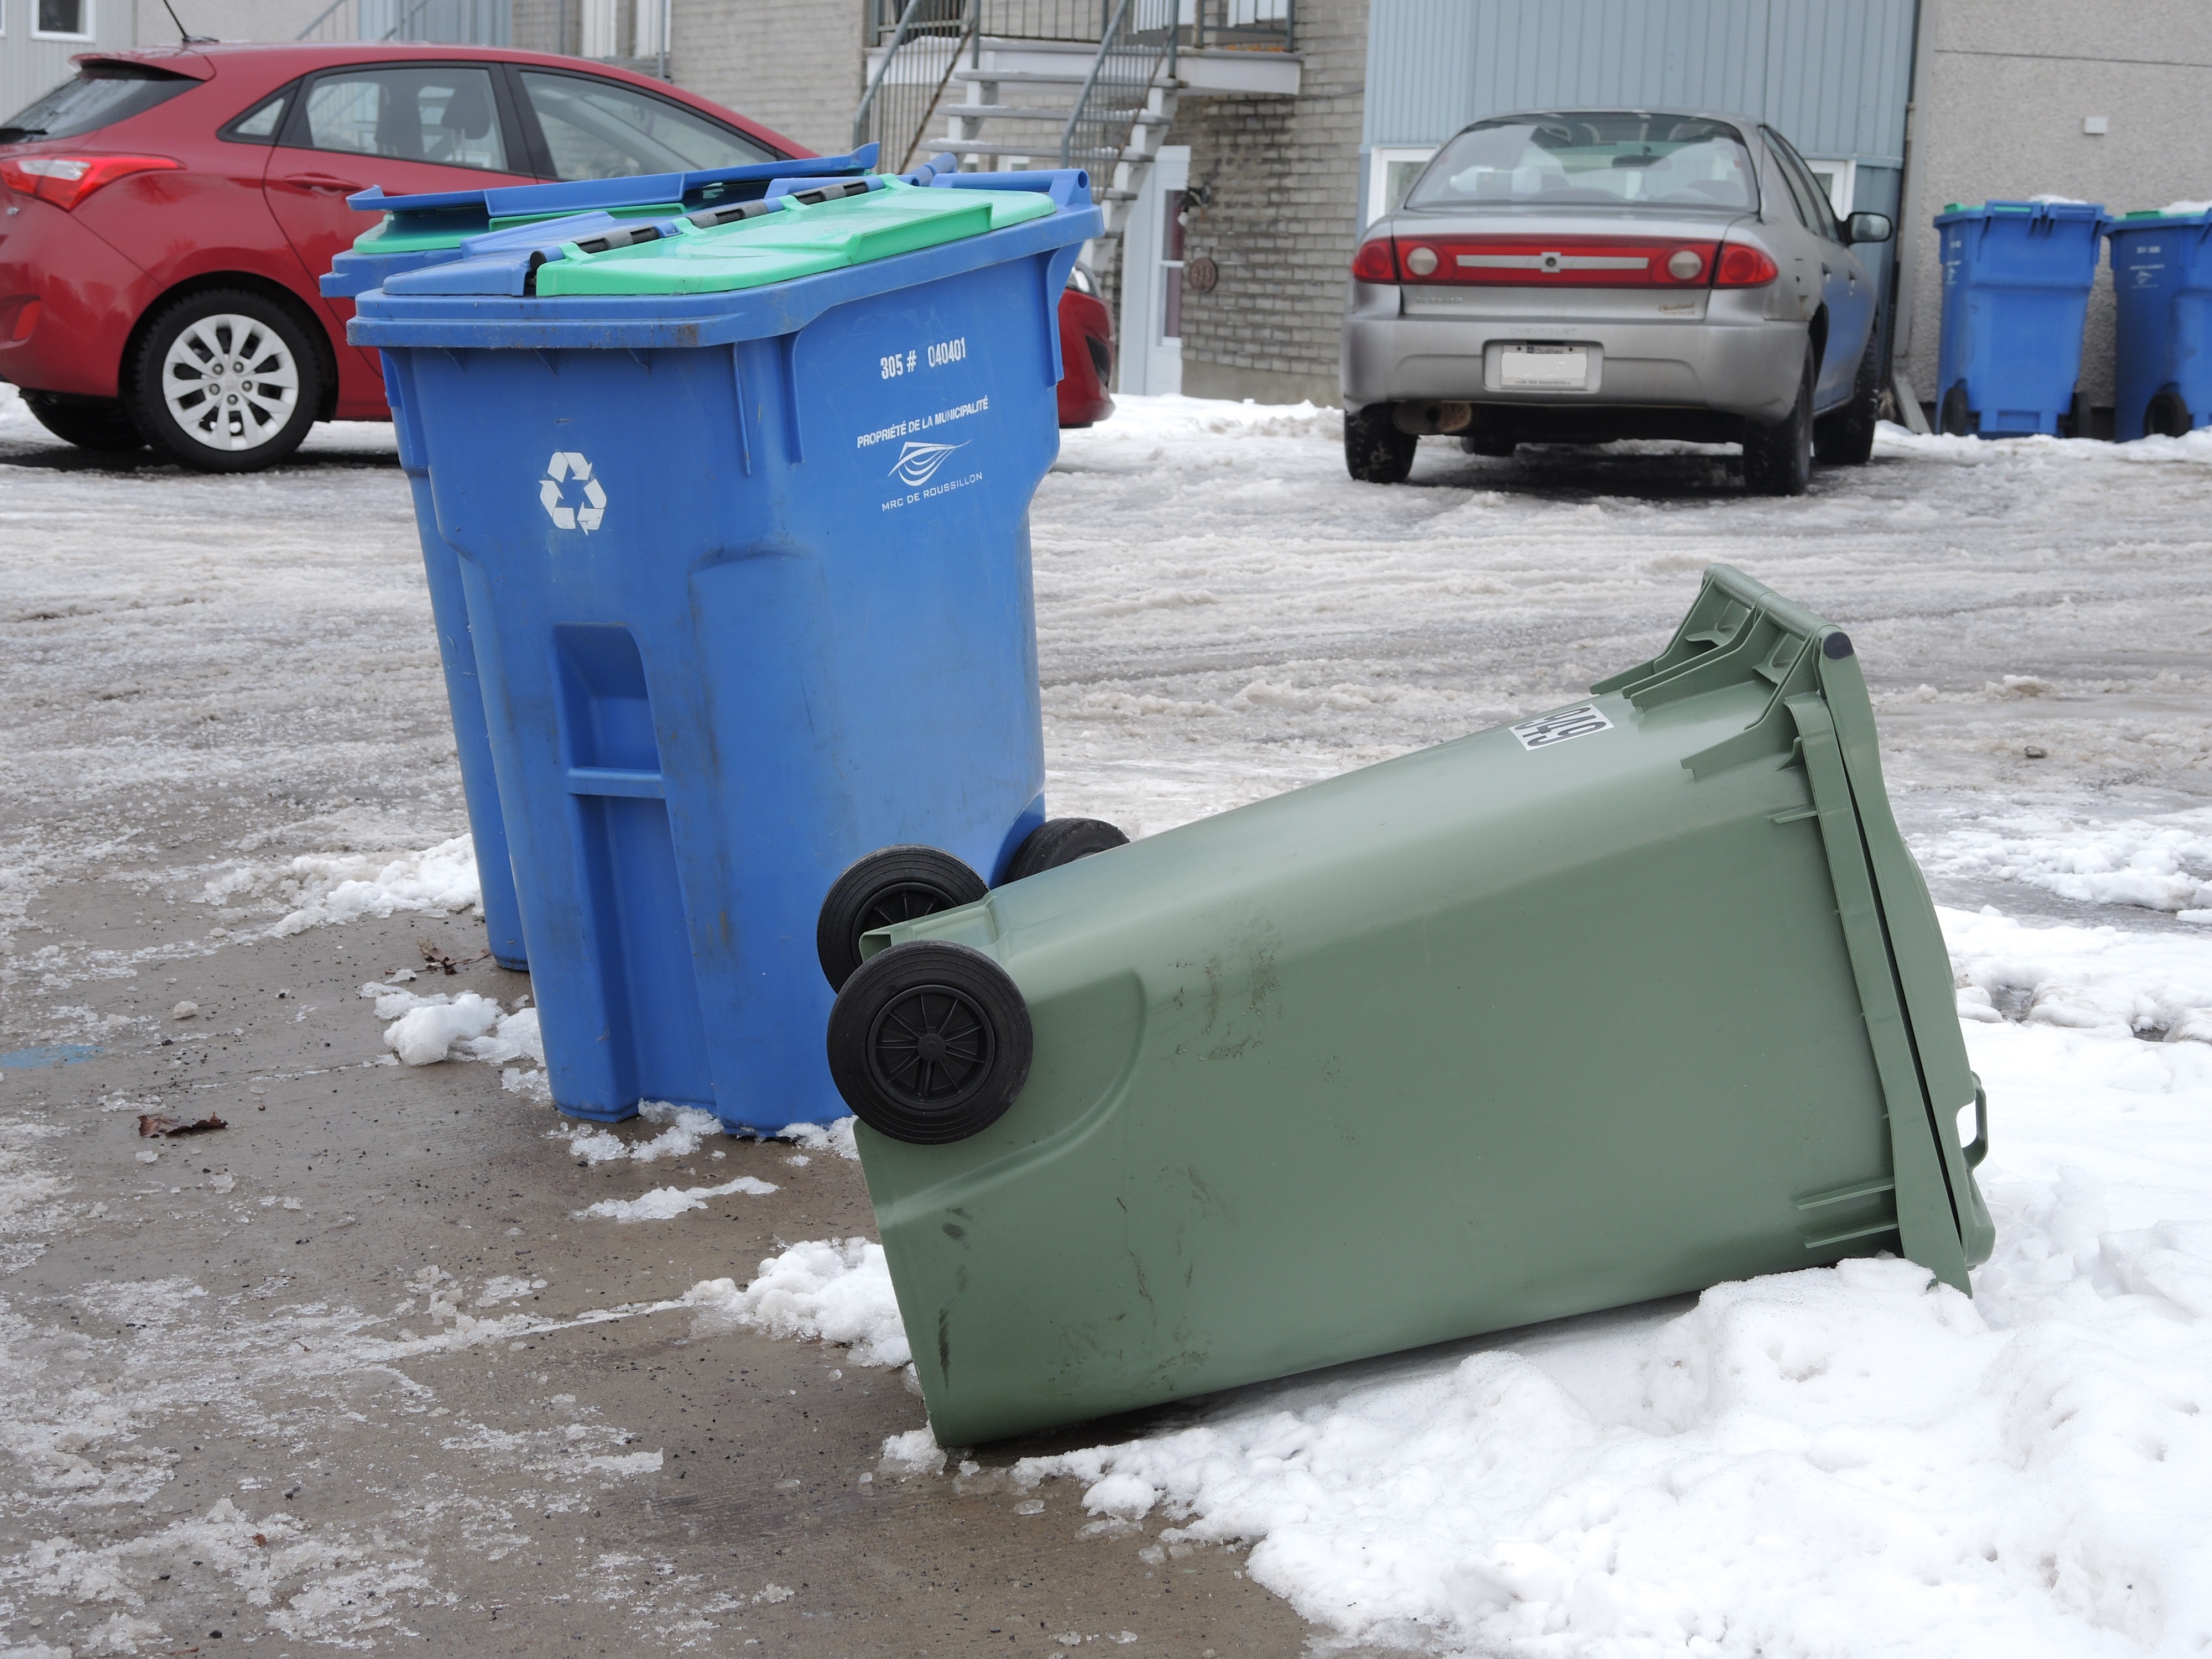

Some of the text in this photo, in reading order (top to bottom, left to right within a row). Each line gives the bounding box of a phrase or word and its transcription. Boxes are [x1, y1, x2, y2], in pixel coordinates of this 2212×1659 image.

[880, 337, 967, 380] 305 # 040401
[857, 395, 988, 448] PROPRIÉTÉ DE LA MUNICIPALITÉ
[881, 472, 983, 512] MRC DE ROUSSILLON
[1514, 707, 1606, 747] 949
